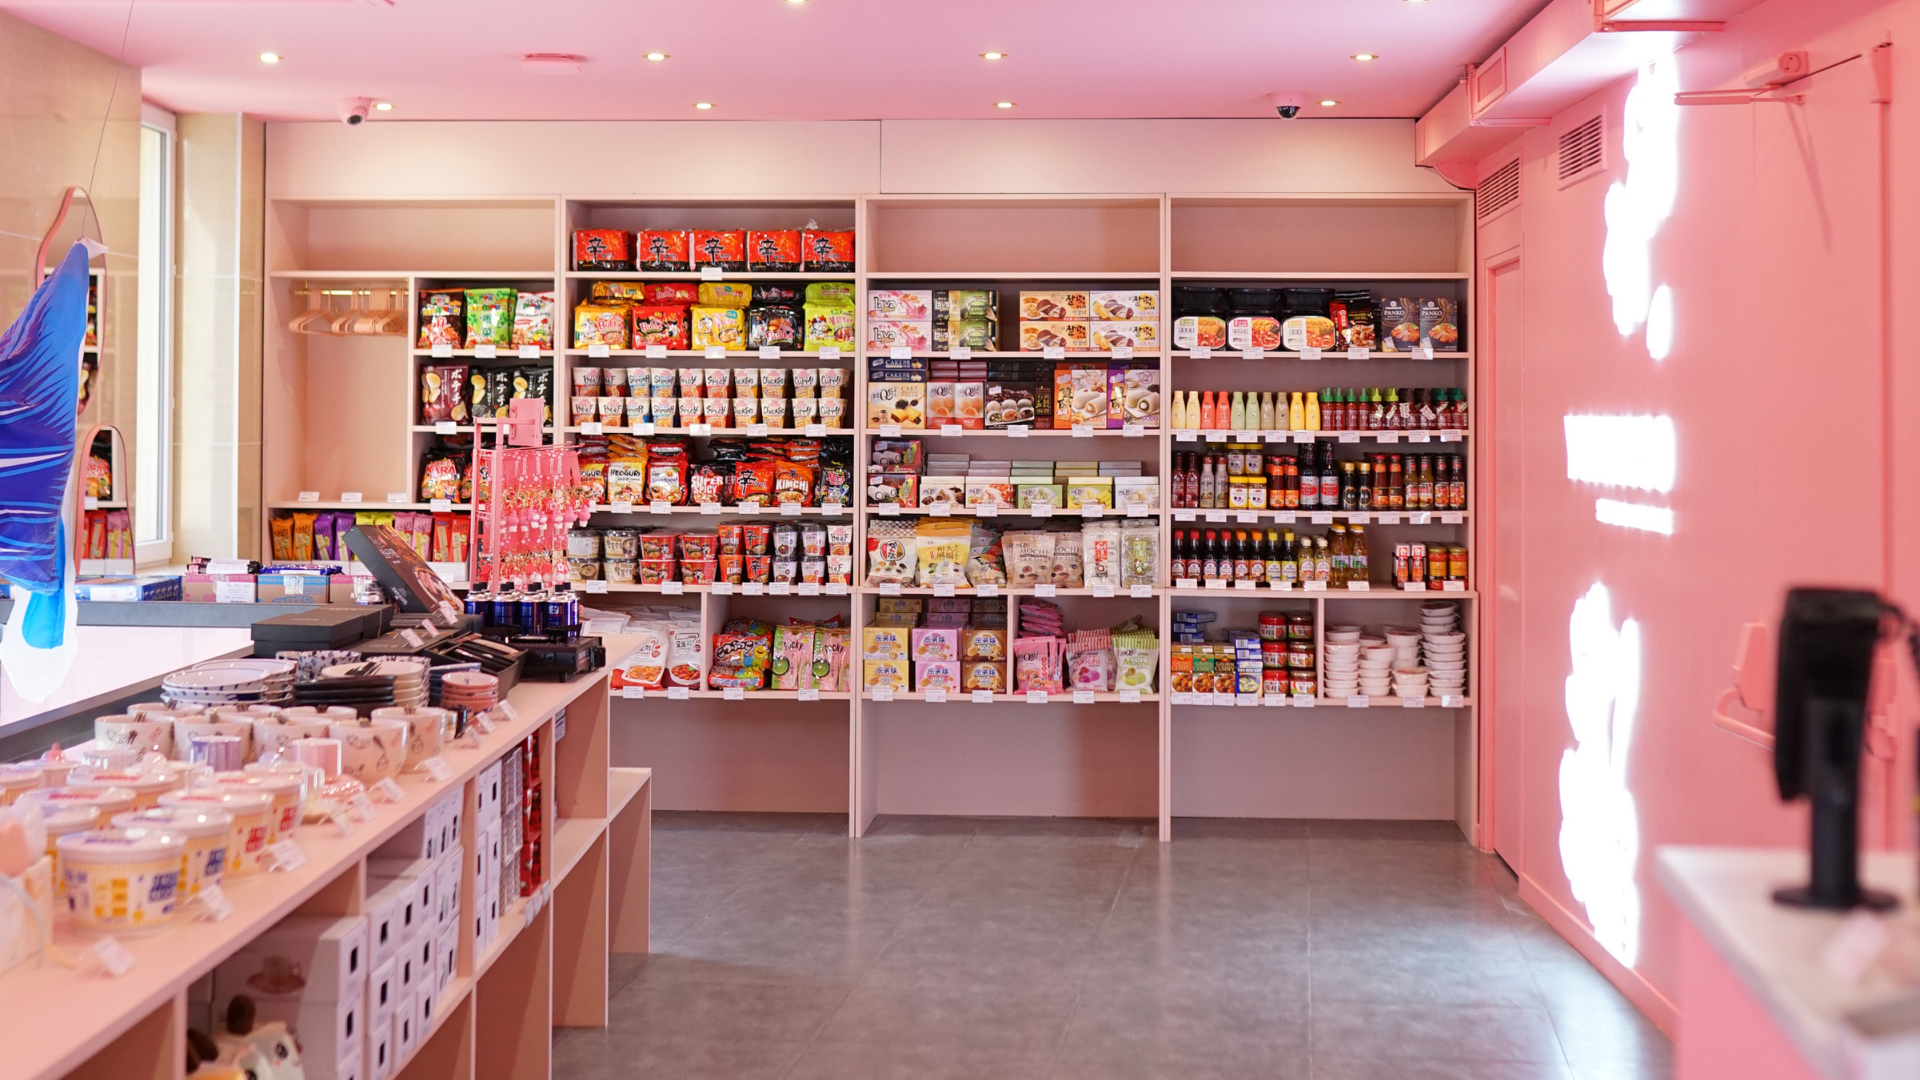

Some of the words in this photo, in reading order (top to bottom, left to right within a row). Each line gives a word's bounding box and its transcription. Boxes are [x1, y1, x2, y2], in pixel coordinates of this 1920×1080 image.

[586, 236, 606, 264] 辛
[650, 236, 670, 265] 辛
[704, 237, 724, 266] 辛
[759, 238, 779, 266] 辛
[814, 237, 834, 265] 辛
[610, 468, 640, 477] NEOGURI
[692, 474, 724, 486] SUPER
[738, 469, 758, 495] 辛
[694, 486, 718, 494] SPICY
[776, 480, 809, 492] KIMCHI
[1123, 658, 1149, 667] Mochi
